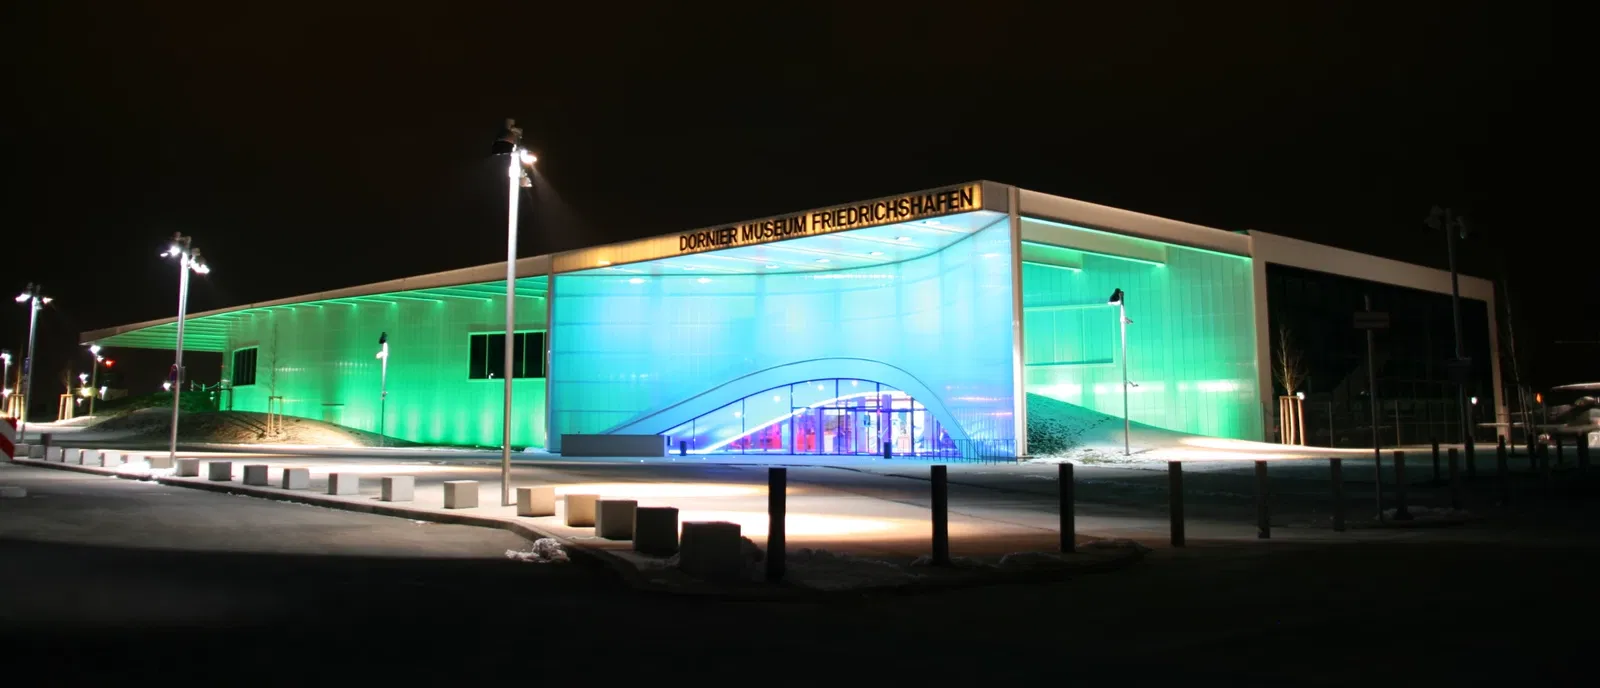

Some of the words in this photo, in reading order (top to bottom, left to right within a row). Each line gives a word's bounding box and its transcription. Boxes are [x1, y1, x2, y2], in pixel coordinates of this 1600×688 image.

[679, 227, 738, 251] DORNIER
[741, 215, 807, 241] MUSEUM
[812, 187, 974, 231] FRIEDRICHSHAFEN
